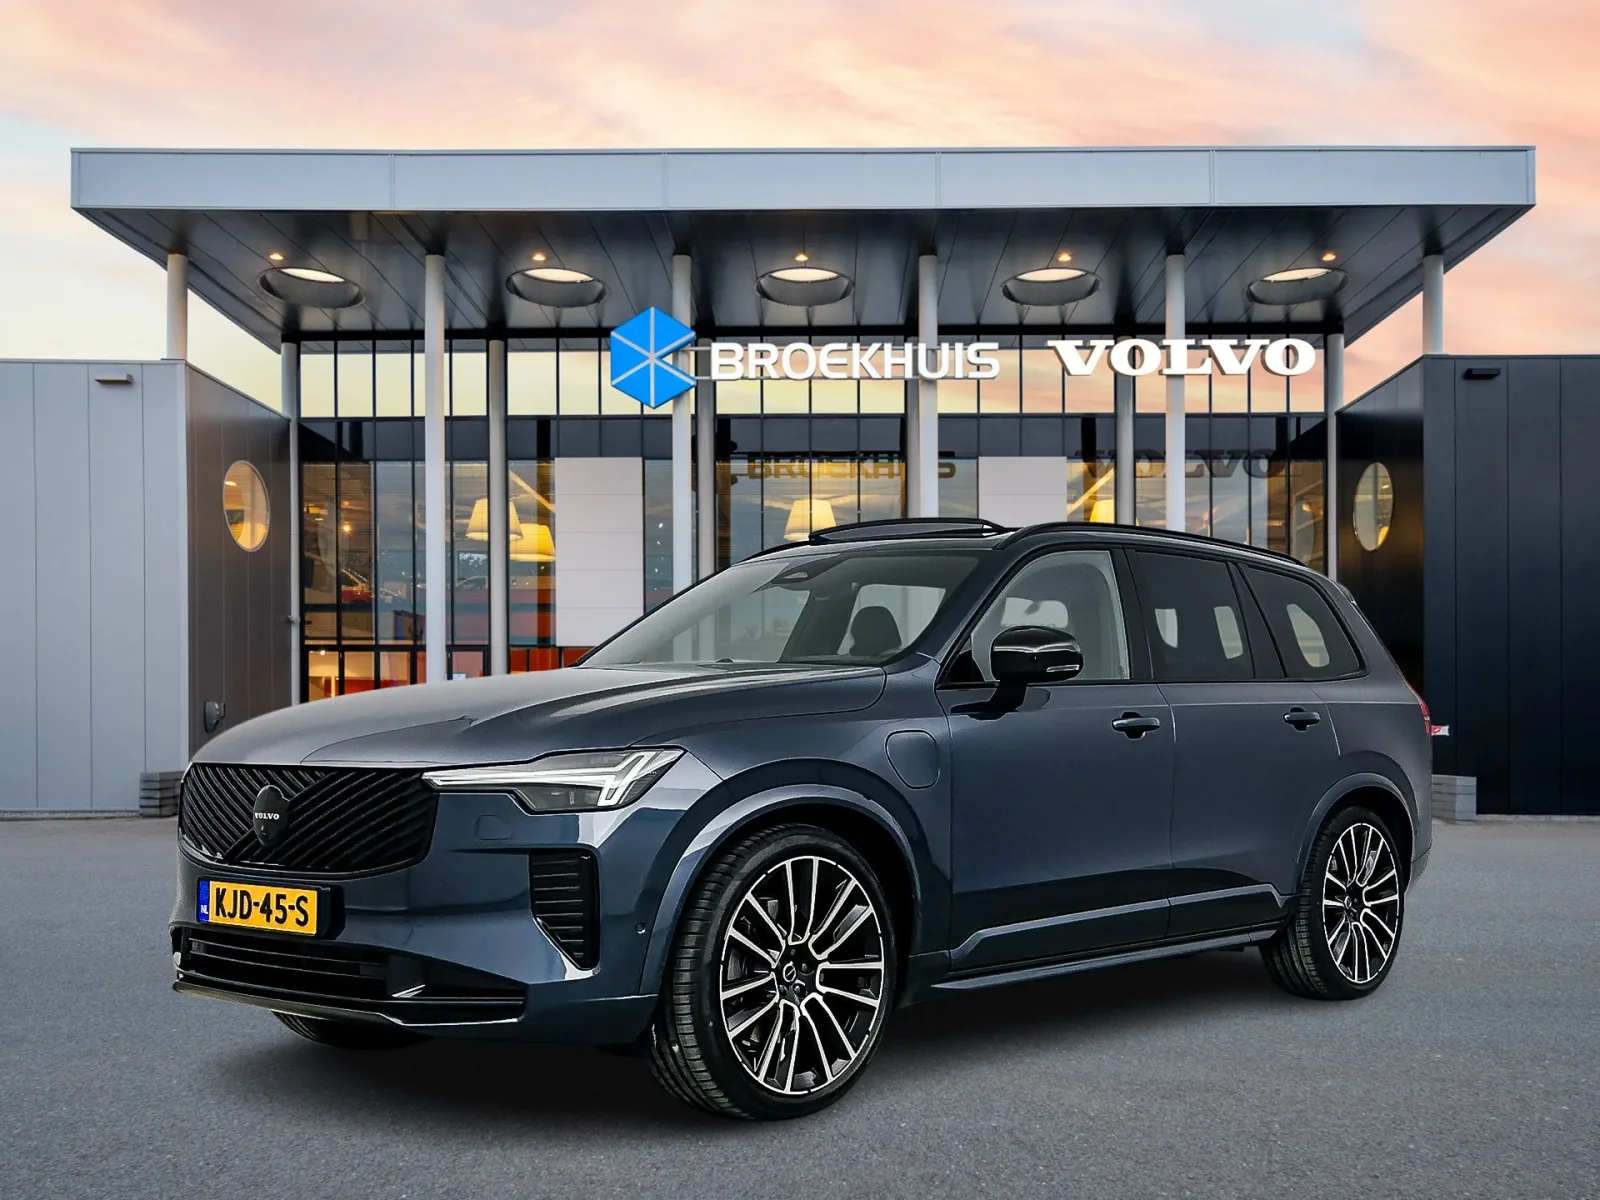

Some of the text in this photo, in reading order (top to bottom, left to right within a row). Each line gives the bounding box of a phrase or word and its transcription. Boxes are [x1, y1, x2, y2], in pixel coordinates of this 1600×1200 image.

[711, 342, 1000, 379] BROEKHUIS
[1047, 338, 1316, 376] VOLVO
[747, 452, 957, 479] BROEKHS
[254, 811, 280, 820] VOLVO
[200, 904, 209, 915] NL
[215, 887, 309, 927] KJD-45-S
